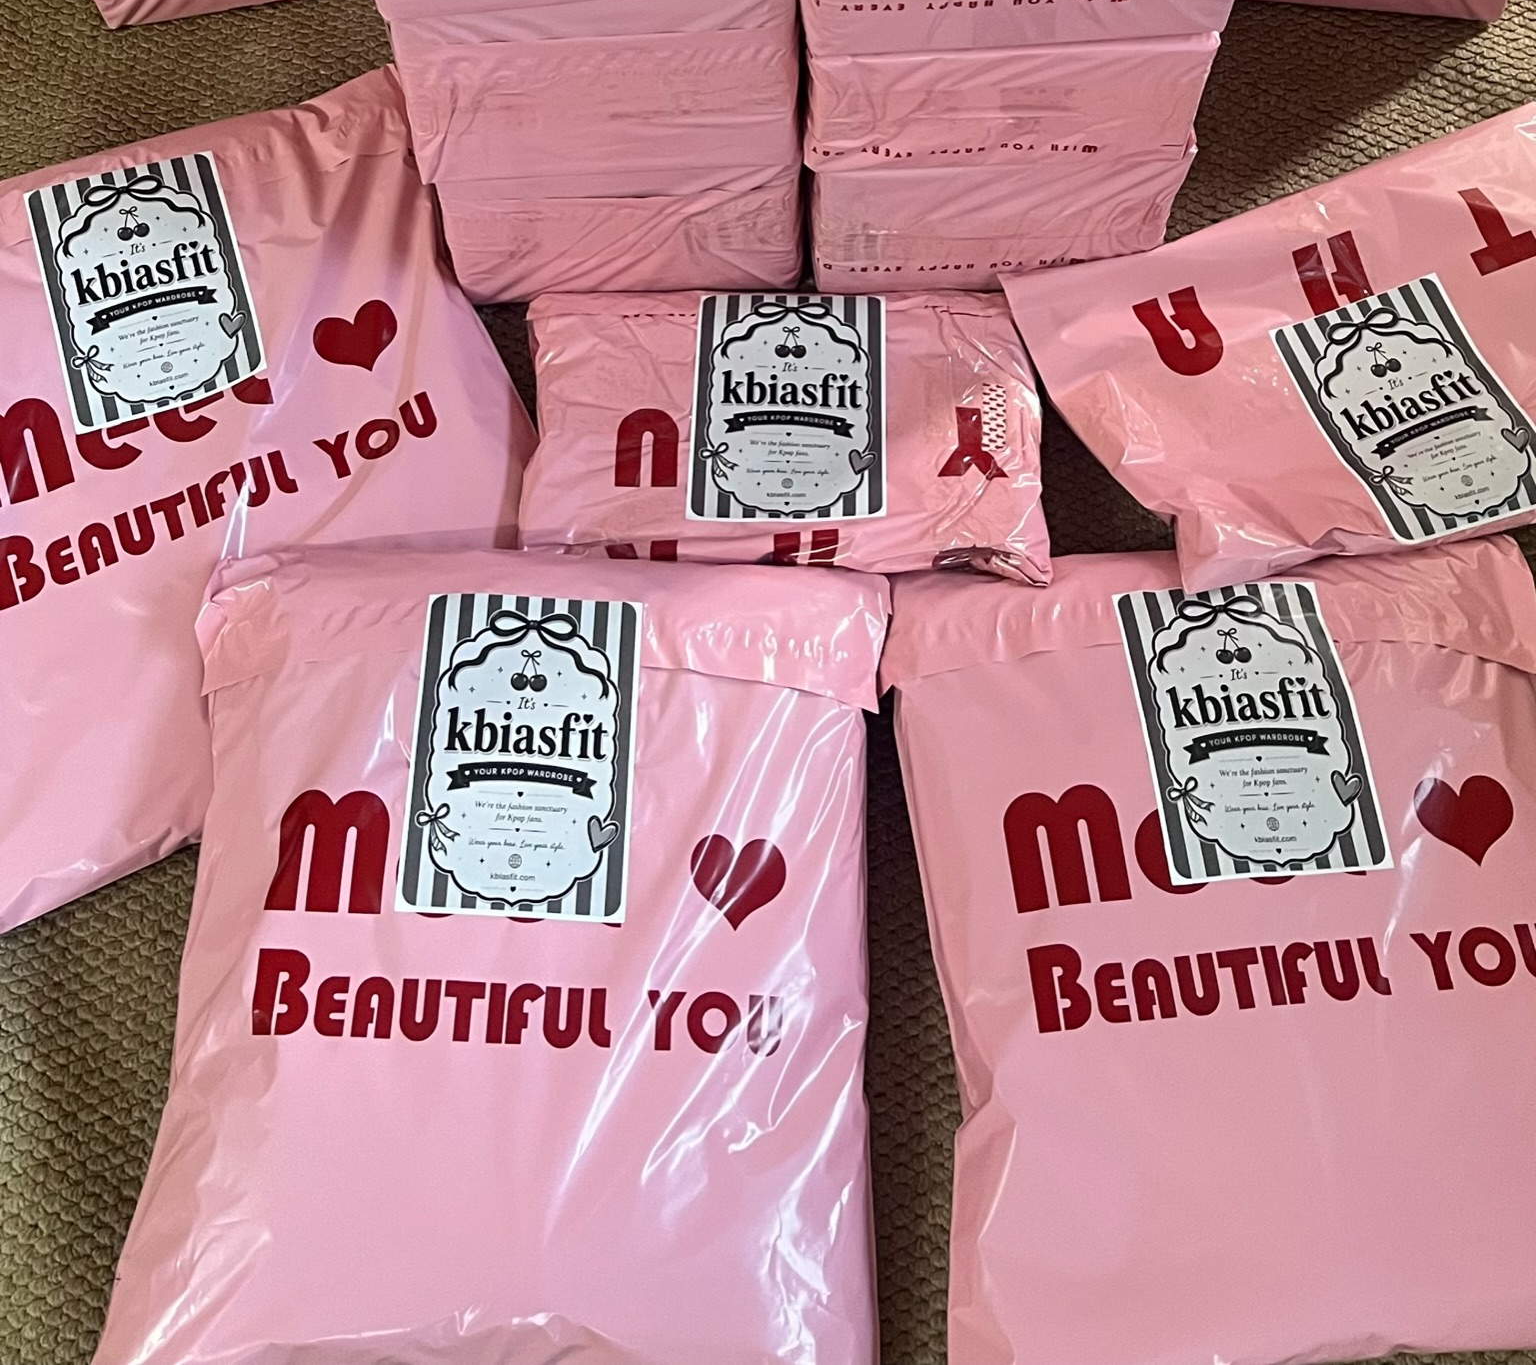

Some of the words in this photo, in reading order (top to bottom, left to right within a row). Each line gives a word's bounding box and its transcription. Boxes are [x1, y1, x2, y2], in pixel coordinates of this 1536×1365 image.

[927, 0, 993, 9] HAPPY
[130, 241, 146, 255] It's
[70, 239, 218, 305] kbiasfit
[108, 305, 130, 317] YOUR
[131, 298, 153, 310] KPOP
[154, 290, 195, 304] WARDROBE
[147, 323, 169, 334] fashion
[170, 315, 198, 327] sanctuary
[139, 337, 149, 345] for
[149, 332, 165, 341] Kpop
[781, 361, 798, 372] It's
[149, 372, 188, 386] kbiasfit.com
[1387, 376, 1405, 390] It's
[720, 369, 862, 408] kbiasfit
[1339, 369, 1481, 440] kbiasfit
[0, 450, 299, 610] BEAUTIFUL
[313, 392, 437, 478] YOU
[1230, 667, 1249, 681] It's
[516, 696, 536, 710] It's
[1165, 676, 1330, 728] kbiasfit
[443, 706, 608, 760] kbiasfit
[1208, 736, 1232, 747] YOUR
[1233, 733, 1257, 742] KPOP
[1258, 733, 1304, 742] WARDROBE
[474, 767, 497, 775] YOUR
[499, 767, 525, 775] KPOP
[527, 768, 573, 782] WARDROBE
[1250, 767, 1275, 777] fashion
[1276, 766, 1307, 774] sanctuary
[1242, 779, 1252, 789] for
[1253, 779, 1270, 788] Kpop
[495, 801, 506, 809] the
[506, 802, 533, 811] fashion
[534, 805, 568, 814] sanctuary
[494, 812, 506, 822] for
[506, 813, 525, 823] Kpop
[489, 872, 535, 881] kbiasfit.com
[1027, 937, 1392, 1034] BEAUTIFUL
[252, 948, 611, 1048] BEAUTIFUL
[648, 990, 785, 1058] YOU
